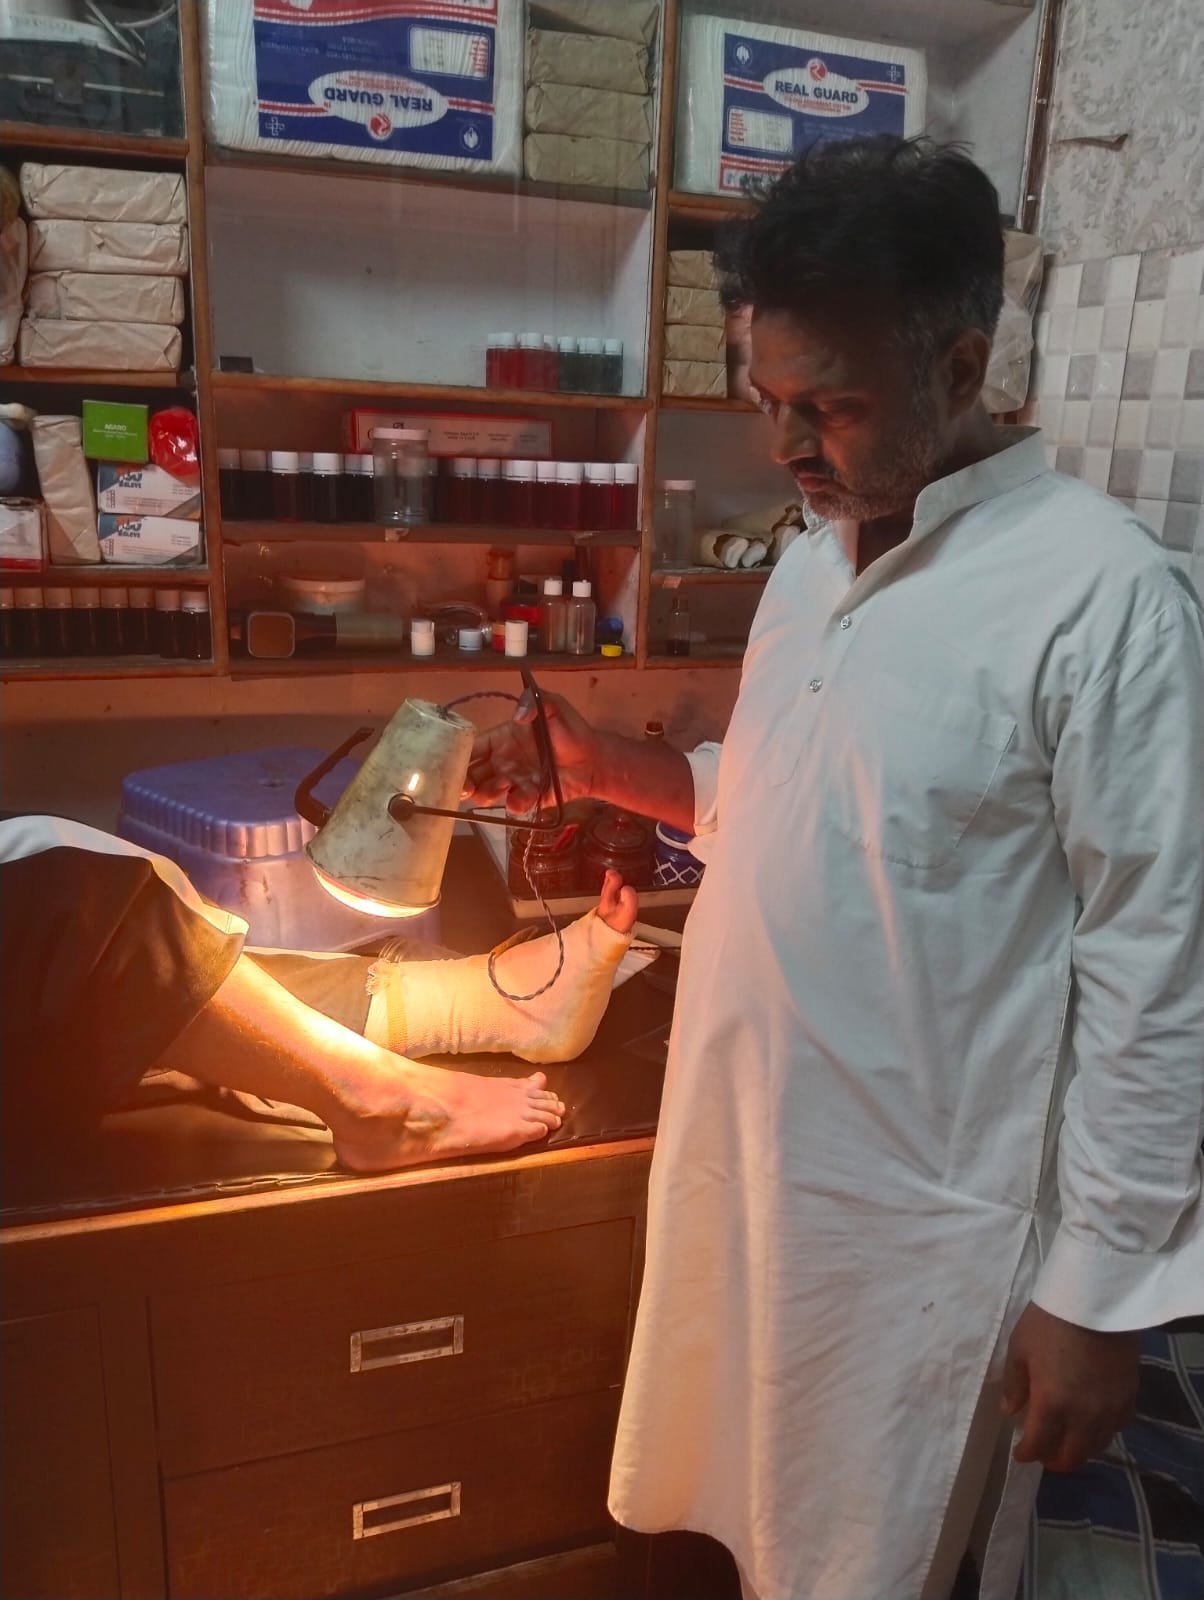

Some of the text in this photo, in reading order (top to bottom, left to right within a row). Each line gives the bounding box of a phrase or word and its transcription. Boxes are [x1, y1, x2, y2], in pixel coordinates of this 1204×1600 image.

[324, 88, 385, 105] GUARD
[775, 80, 859, 104] REAL GUARD
[390, 95, 433, 111] REAL
